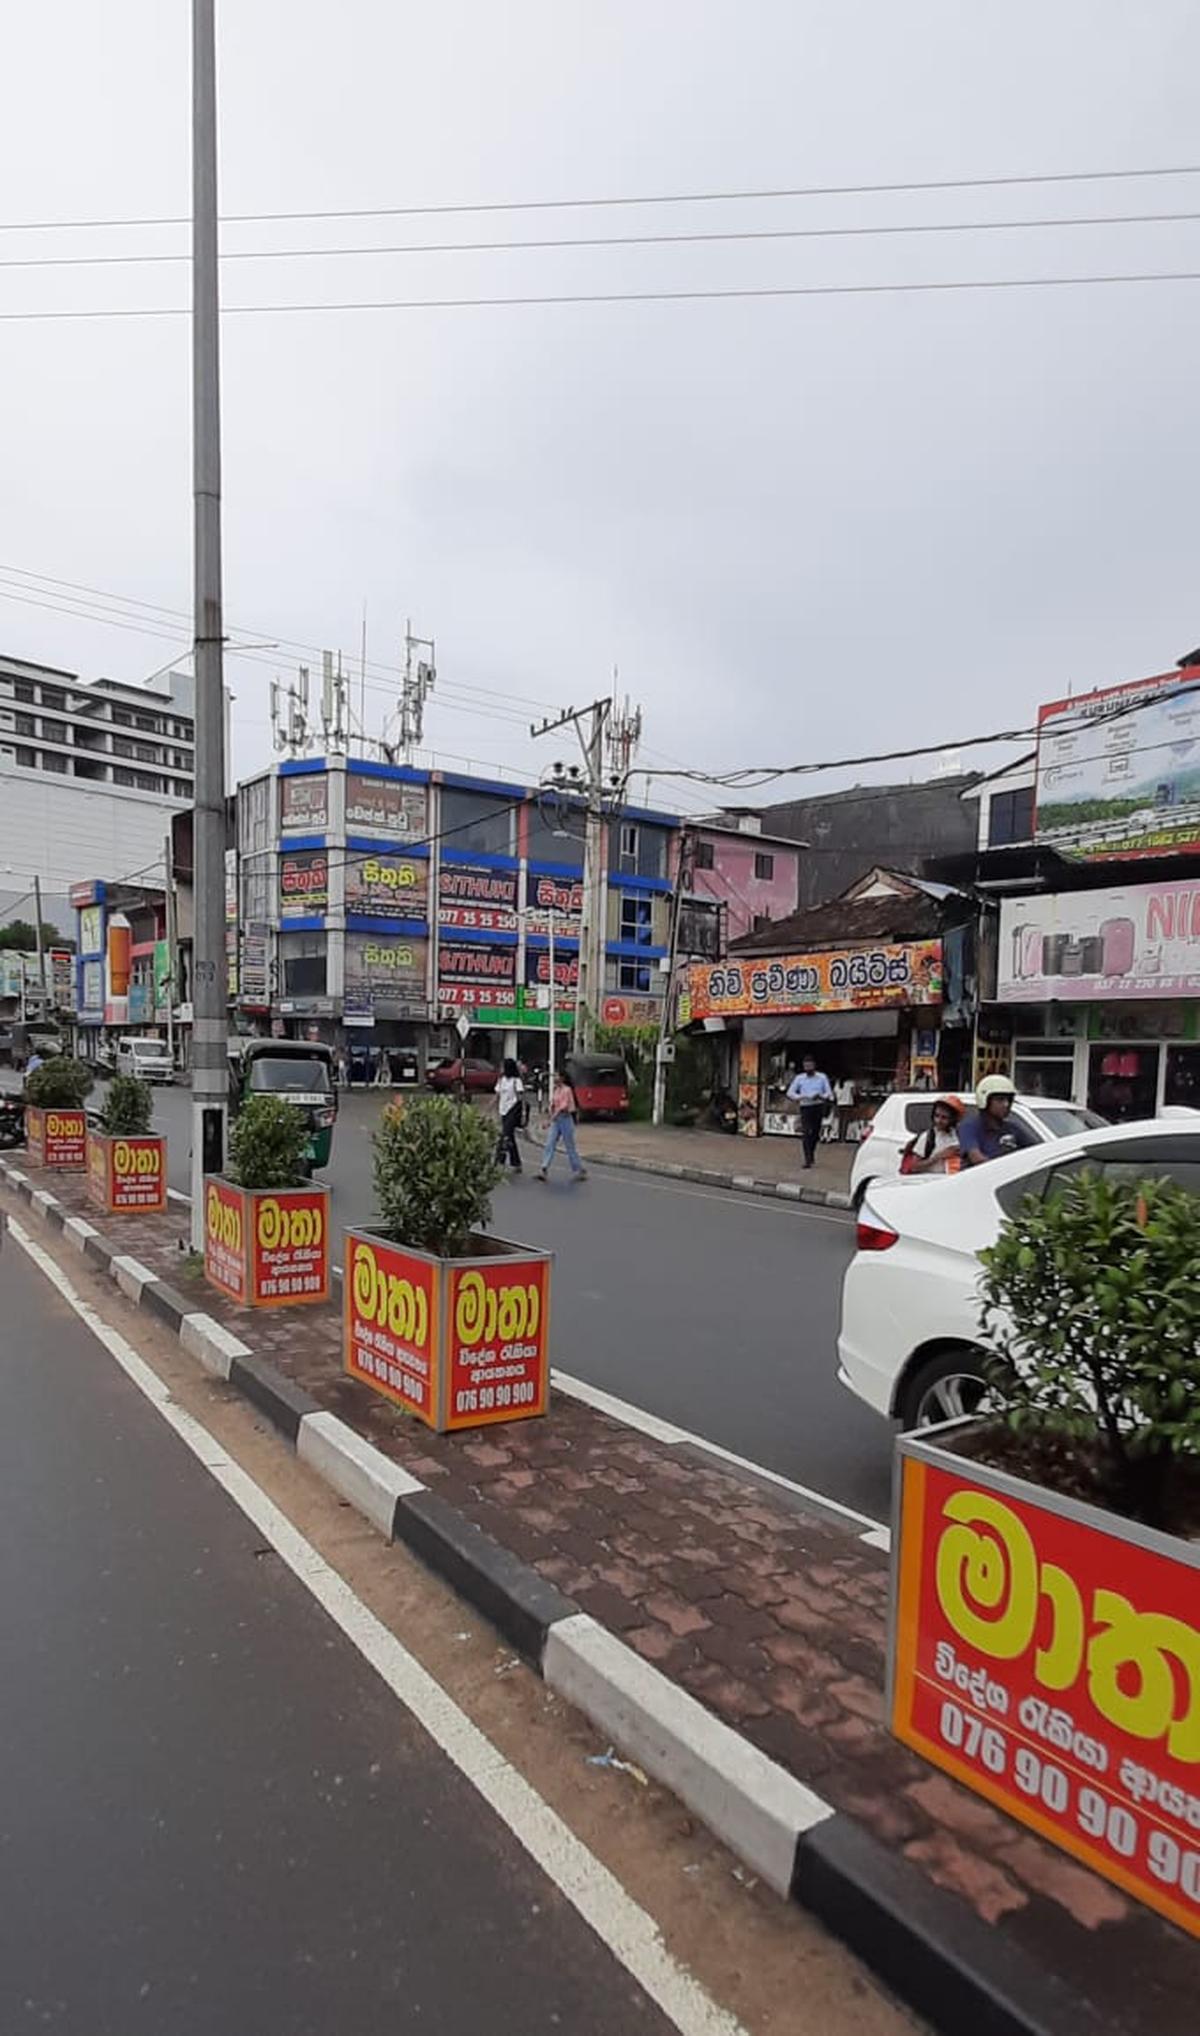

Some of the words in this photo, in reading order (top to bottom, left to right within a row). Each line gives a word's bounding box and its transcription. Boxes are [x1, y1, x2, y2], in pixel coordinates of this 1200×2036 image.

[439, 873, 515, 900] SITHUKI
[438, 910, 458, 924] 077
[463, 912, 476, 925] 25
[480, 913, 493, 927] 25
[439, 949, 514, 976] SITHUKI
[438, 987, 458, 1001] 077
[462, 989, 476, 1003] 25
[479, 990, 492, 1004] 25
[495, 992, 515, 1006] 250
[456, 1389, 477, 1412] 076
[479, 1387, 494, 1409] 90
[496, 1385, 511, 1406] 90
[513, 1382, 534, 1404] 900
[940, 1701, 1006, 1775] 076
[1014, 1748, 1069, 1813] 90
[1077, 1787, 1137, 1857] 90
